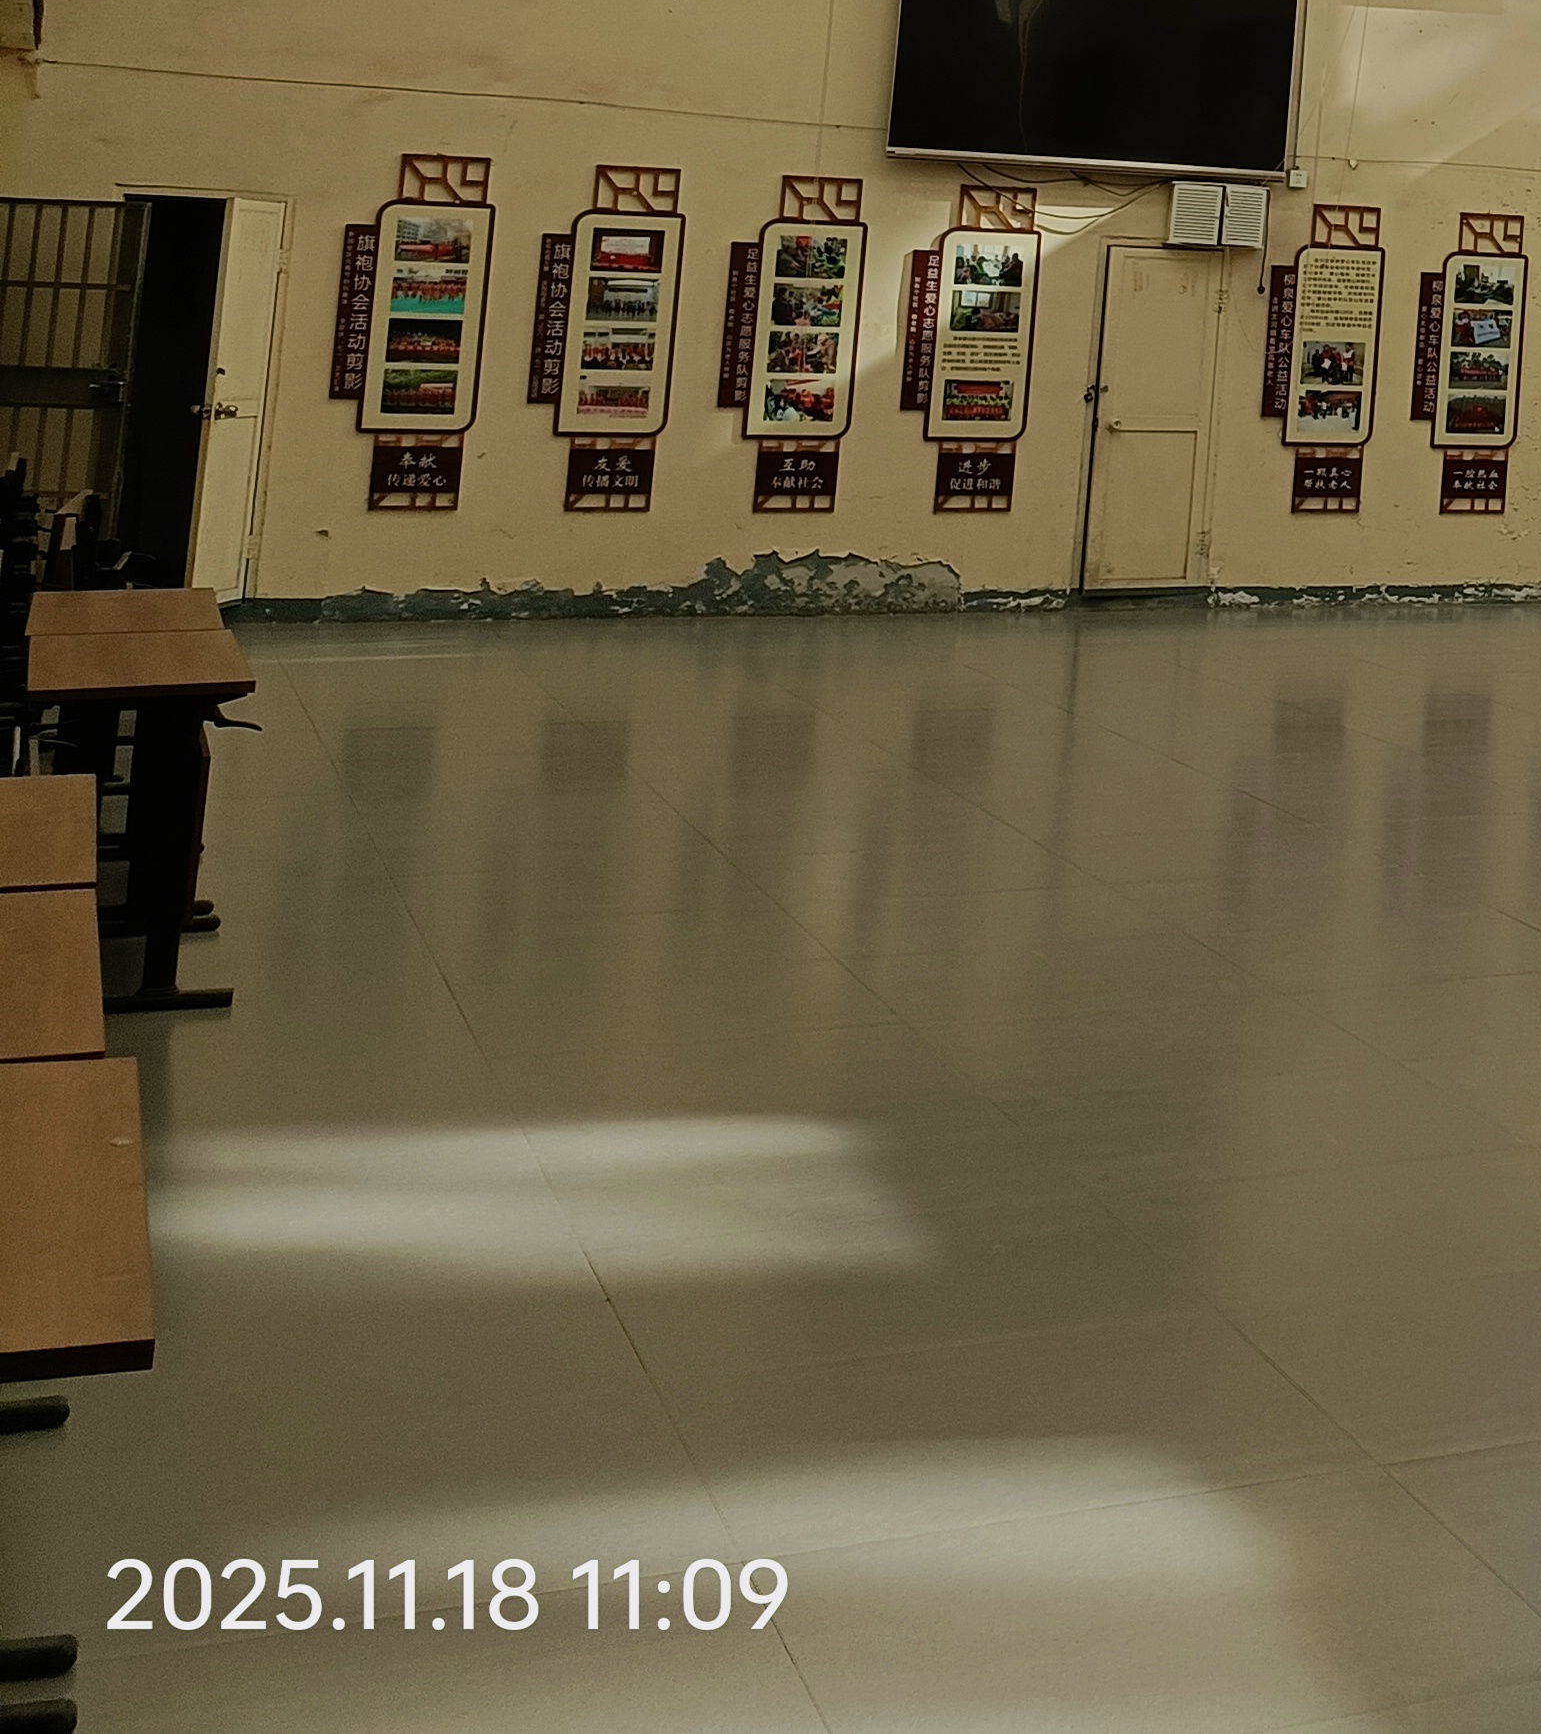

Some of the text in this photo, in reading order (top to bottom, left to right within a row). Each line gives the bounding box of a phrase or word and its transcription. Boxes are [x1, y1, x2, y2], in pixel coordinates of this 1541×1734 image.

[343, 234, 377, 391] 旗袍协会活动剪影
[541, 243, 572, 395] 旗袍协会活动剪影
[916, 255, 940, 405] 足益生爱心志愿服务队剪影
[1274, 273, 1296, 411] 柳泉爱心车队公益活动
[1422, 280, 1444, 414] 柳泉爱心车队公益活动
[398, 452, 438, 468] 奉献
[593, 456, 634, 472] 友爱
[778, 458, 817, 472] 互助
[957, 459, 992, 475] 进步
[386, 473, 447, 488] 传递爱心
[1303, 467, 1353, 478] 一颗真心
[582, 475, 639, 488] 传播文明
[949, 478, 1002, 491] 促进和谐
[1452, 480, 1499, 491] 奉献社会
